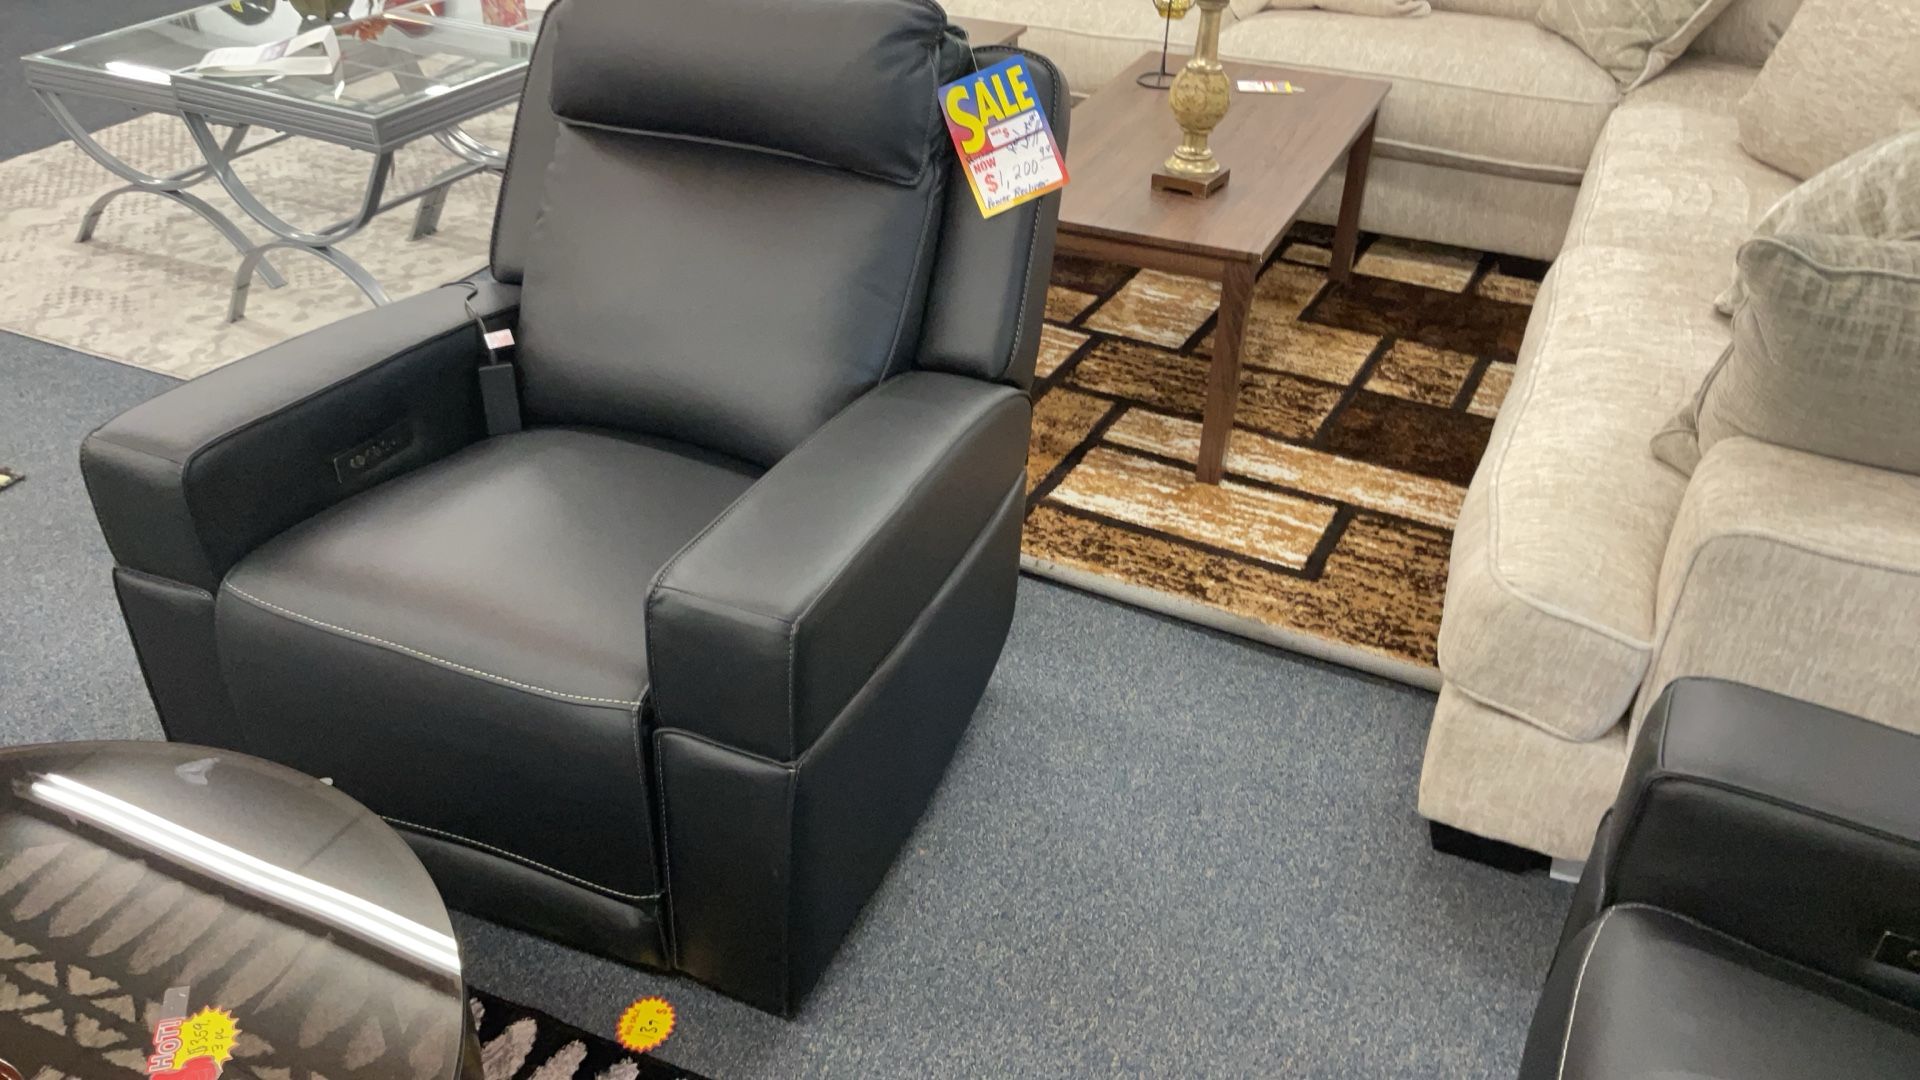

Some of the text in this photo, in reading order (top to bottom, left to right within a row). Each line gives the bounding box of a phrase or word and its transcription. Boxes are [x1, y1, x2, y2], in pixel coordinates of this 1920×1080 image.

[946, 64, 1036, 154] SALE
[973, 157, 997, 174] NOW
[148, 1020, 183, 1072] HOT!
